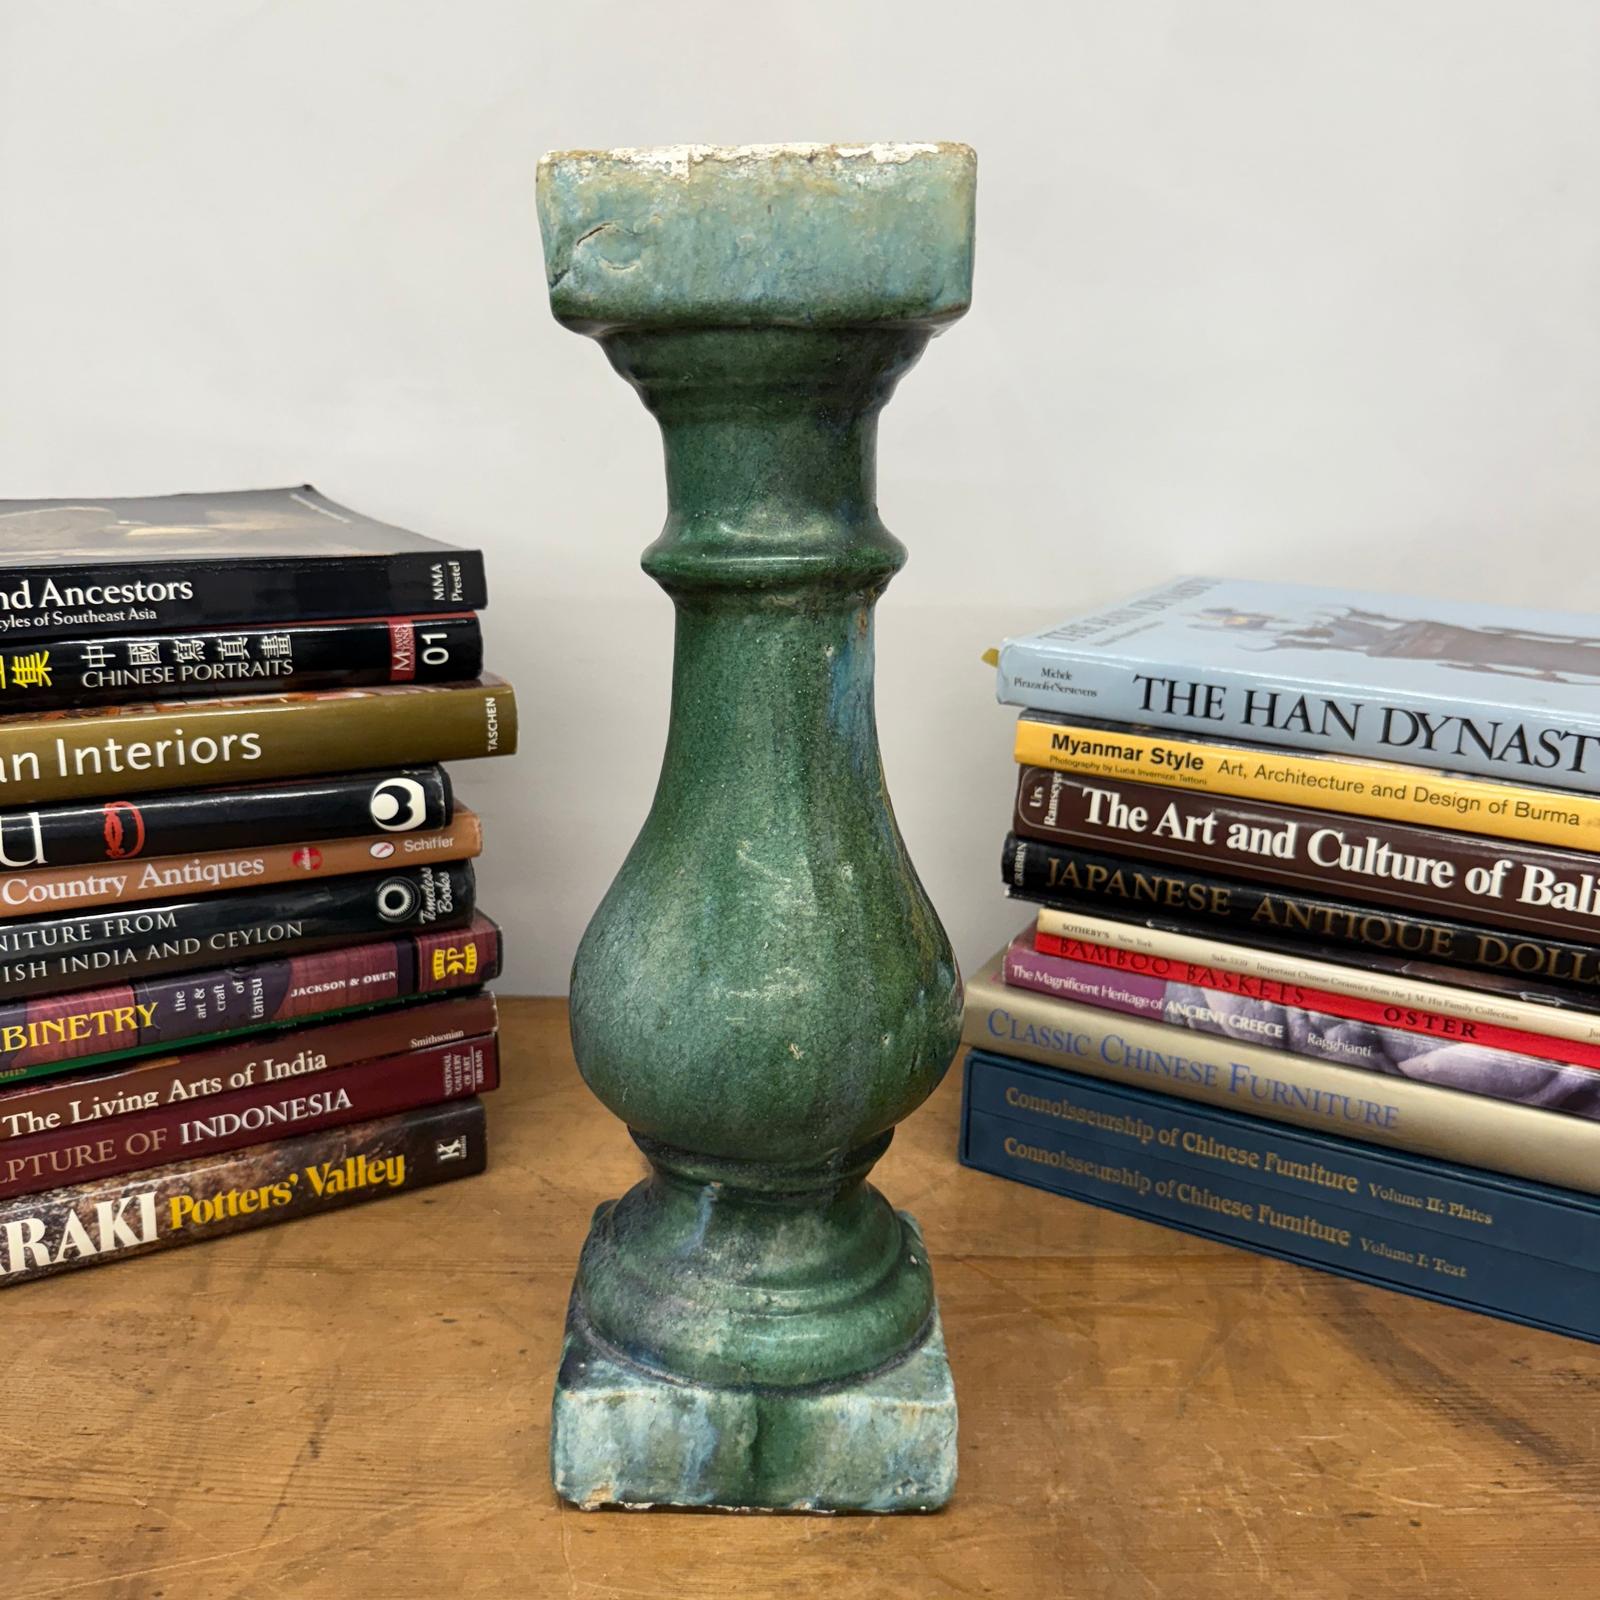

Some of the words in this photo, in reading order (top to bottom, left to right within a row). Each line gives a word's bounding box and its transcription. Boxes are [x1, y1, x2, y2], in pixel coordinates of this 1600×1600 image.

[39, 578, 194, 608] Ancestors
[431, 563, 445, 600] MMA
[448, 560, 463, 602] Prestel
[34, 612, 51, 627] of
[52, 610, 126, 626] Southeast
[128, 607, 158, 622] Asia
[0, 650, 52, 689] 集
[421, 632, 449, 665] 01
[81, 666, 176, 688] CHINESE
[181, 659, 294, 681] PORTRAITS
[485, 697, 499, 752] TASCHEN
[1132, 673, 1227, 721] THE
[1240, 689, 1364, 742] HAN
[1377, 706, 1600, 774] DYNAST
[56, 728, 262, 777] Interiors
[1050, 755, 1101, 772] Photography
[1103, 763, 1114, 774] by
[1115, 765, 1136, 776] Luca
[1029, 786, 1045, 807] Urs
[1051, 733, 1143, 761] Myanmar
[1150, 747, 1204, 771] Style
[1217, 759, 1247, 780] Art,
[1254, 764, 1364, 794] Architecture
[1371, 784, 1407, 800] and
[1413, 786, 1480, 814] Design
[1488, 799, 1509, 815] of
[1514, 801, 1580, 826] Burma
[404, 836, 455, 853] Schiffer
[1081, 787, 1149, 832] The
[1152, 801, 1218, 845] Art
[1226, 822, 1298, 859] and
[1307, 828, 1455, 888] Culture
[1465, 859, 1513, 898] of
[1515, 863, 1600, 916] Bali
[2, 875, 127, 905] Country
[138, 858, 265, 890] Antiques
[419, 866, 437, 925] Timeless
[434, 871, 454, 913] Books
[103, 912, 178, 938] FROM
[1045, 857, 1231, 915] JAPANESE
[1251, 893, 1455, 957] ANTIQUE
[3, 960, 48, 983] ISH
[60, 948, 139, 974] INDIA
[147, 938, 201, 961] AND
[210, 921, 303, 951] CEYLON
[1062, 923, 1109, 940] SOTHEBY'S
[1256, 962, 1296, 978] Important
[1298, 970, 1329, 983] Chinese
[1370, 986, 1390, 997] from
[1392, 990, 1405, 999] the
[1444, 1000, 1473, 1014] Family
[1475, 1006, 1519, 1021] Collection
[174, 990, 187, 1012] the
[194, 988, 206, 1000] &
[213, 984, 226, 1012] craft
[233, 981, 245, 994] of
[251, 977, 265, 1020] tansu
[291, 980, 346, 997] JACKSON
[350, 977, 360, 987] &
[363, 971, 397, 985] OWEN
[1060, 937, 1170, 974] BAMBOO
[1186, 962, 1305, 1004] BASKETS
[1383, 1007, 1478, 1039] OSTER
[0, 1002, 159, 1053] BINETRY
[194, 1003, 207, 1019] art
[1012, 964, 1034, 980] The
[1034, 971, 1100, 996] Magnificent
[1101, 985, 1149, 1009] Heritage
[1150, 997, 1164, 1010] of
[1165, 1000, 1227, 1024] ANCIENT
[1228, 1013, 1285, 1038] GREECE
[1307, 1032, 1372, 1058] Ragghianti
[410, 1029, 465, 1048] Smithsonian
[987, 1008, 1091, 1056] CLASSIC
[1100, 1034, 1218, 1088] CHINESE
[1228, 1062, 1399, 1129] FURNITURE
[2, 1110, 61, 1137] The
[69, 1091, 159, 1124] Living
[167, 1078, 222, 1103] Arts
[229, 1062, 257, 1089] of
[263, 1050, 328, 1082] India
[125, 1128, 168, 1156] OF
[180, 1087, 353, 1145] INDONESIA
[305, 1154, 406, 1197] Valley
[1005, 1087, 1154, 1145] Connoisseurship
[1158, 1128, 1180, 1147] of
[1182, 1132, 1260, 1169] Chinese
[1264, 1151, 1360, 1194] Furniture
[1368, 1182, 1423, 1208] Volume
[1448, 1202, 1493, 1225] Plates
[1004, 1137, 1151, 1195] Connoisseurship
[1155, 1178, 1177, 1198] of
[1177, 1182, 1254, 1221] Chinese
[1257, 1204, 1352, 1247] Furniture
[1360, 1237, 1415, 1263] Volume
[1433, 1256, 1468, 1278] Text
